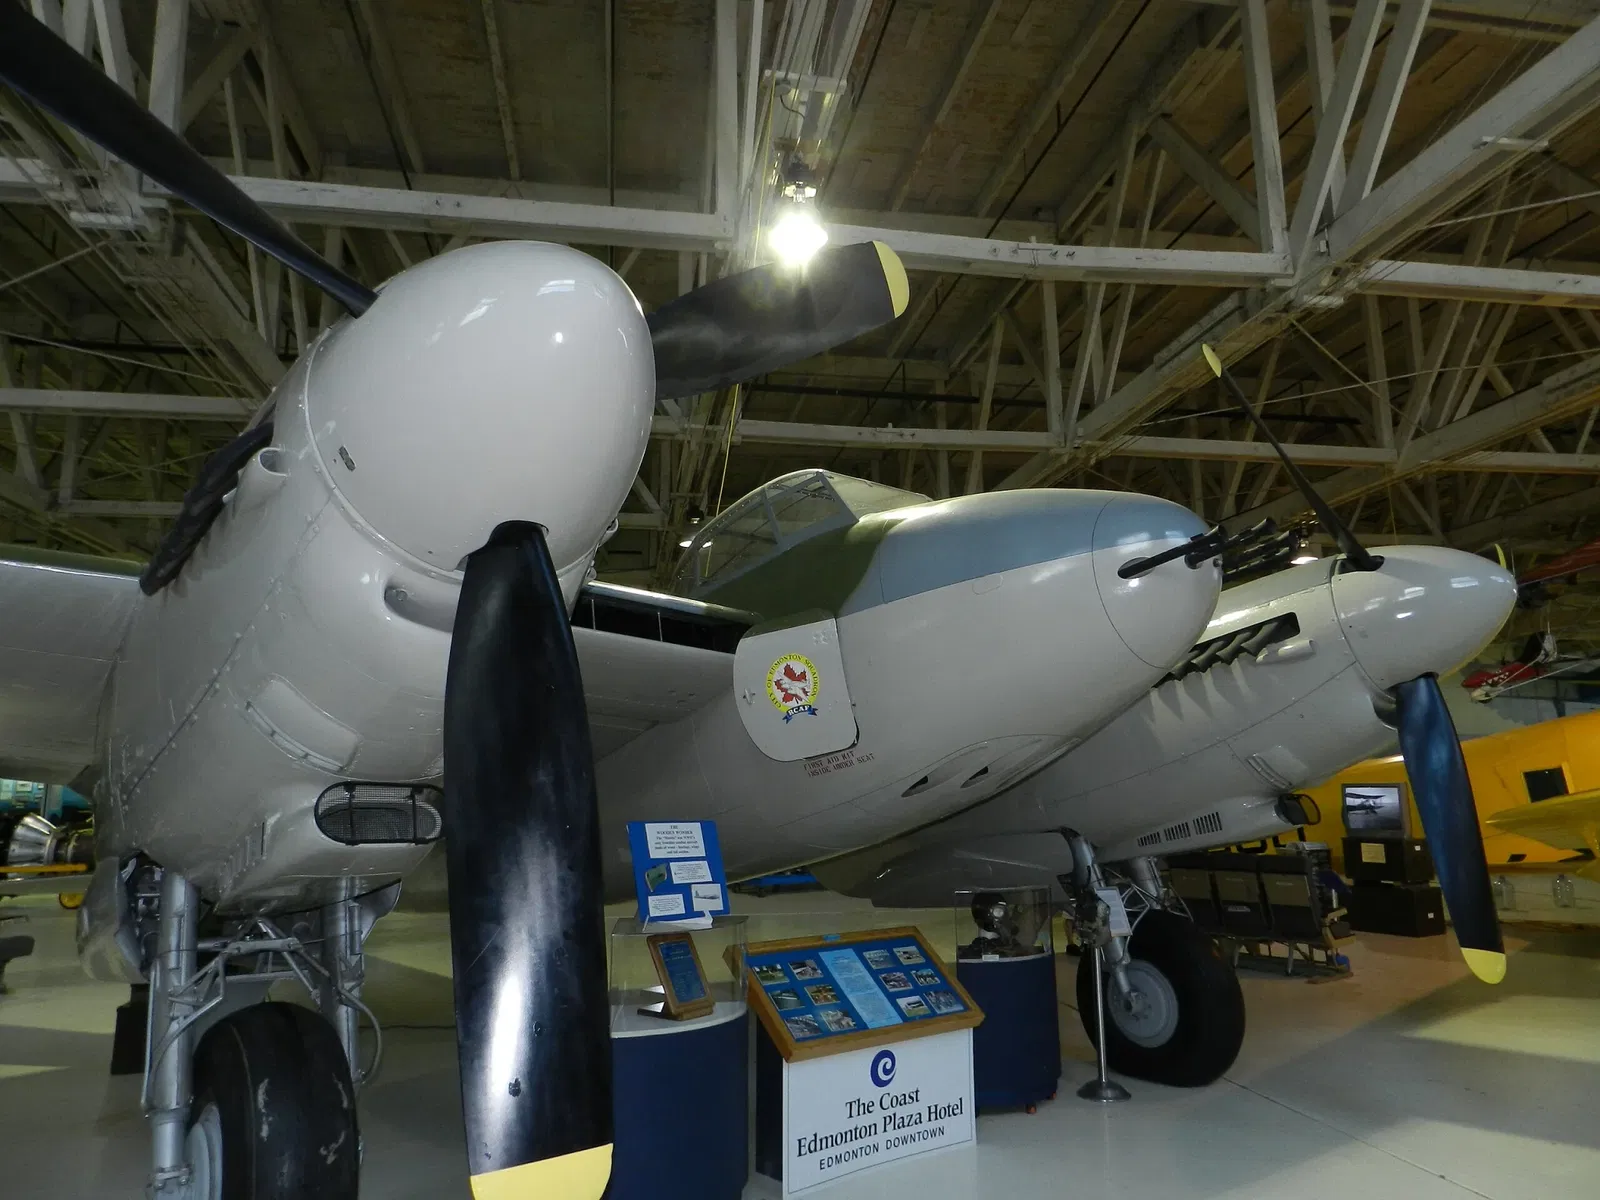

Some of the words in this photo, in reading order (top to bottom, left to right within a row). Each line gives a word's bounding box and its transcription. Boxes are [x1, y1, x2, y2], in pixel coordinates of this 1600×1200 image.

[769, 654, 803, 675] EDMONTON
[805, 659, 818, 696] SQUADRON
[767, 677, 772, 688] OF
[769, 692, 781, 708] CITY
[803, 759, 824, 771] FIRST
[827, 755, 840, 765] AID
[841, 750, 855, 759] KIT
[808, 766, 832, 778] INSIDE
[833, 759, 855, 770] UNDER
[856, 752, 875, 764] SEAT
[845, 1098, 875, 1119] The
[879, 1087, 920, 1111] Coast
[796, 1122, 878, 1158] Edmonton
[882, 1112, 923, 1133] Plaza
[926, 1097, 964, 1123] Hotel
[819, 1142, 880, 1170] EDMONTON
[885, 1126, 945, 1150] DOWNTOWN
